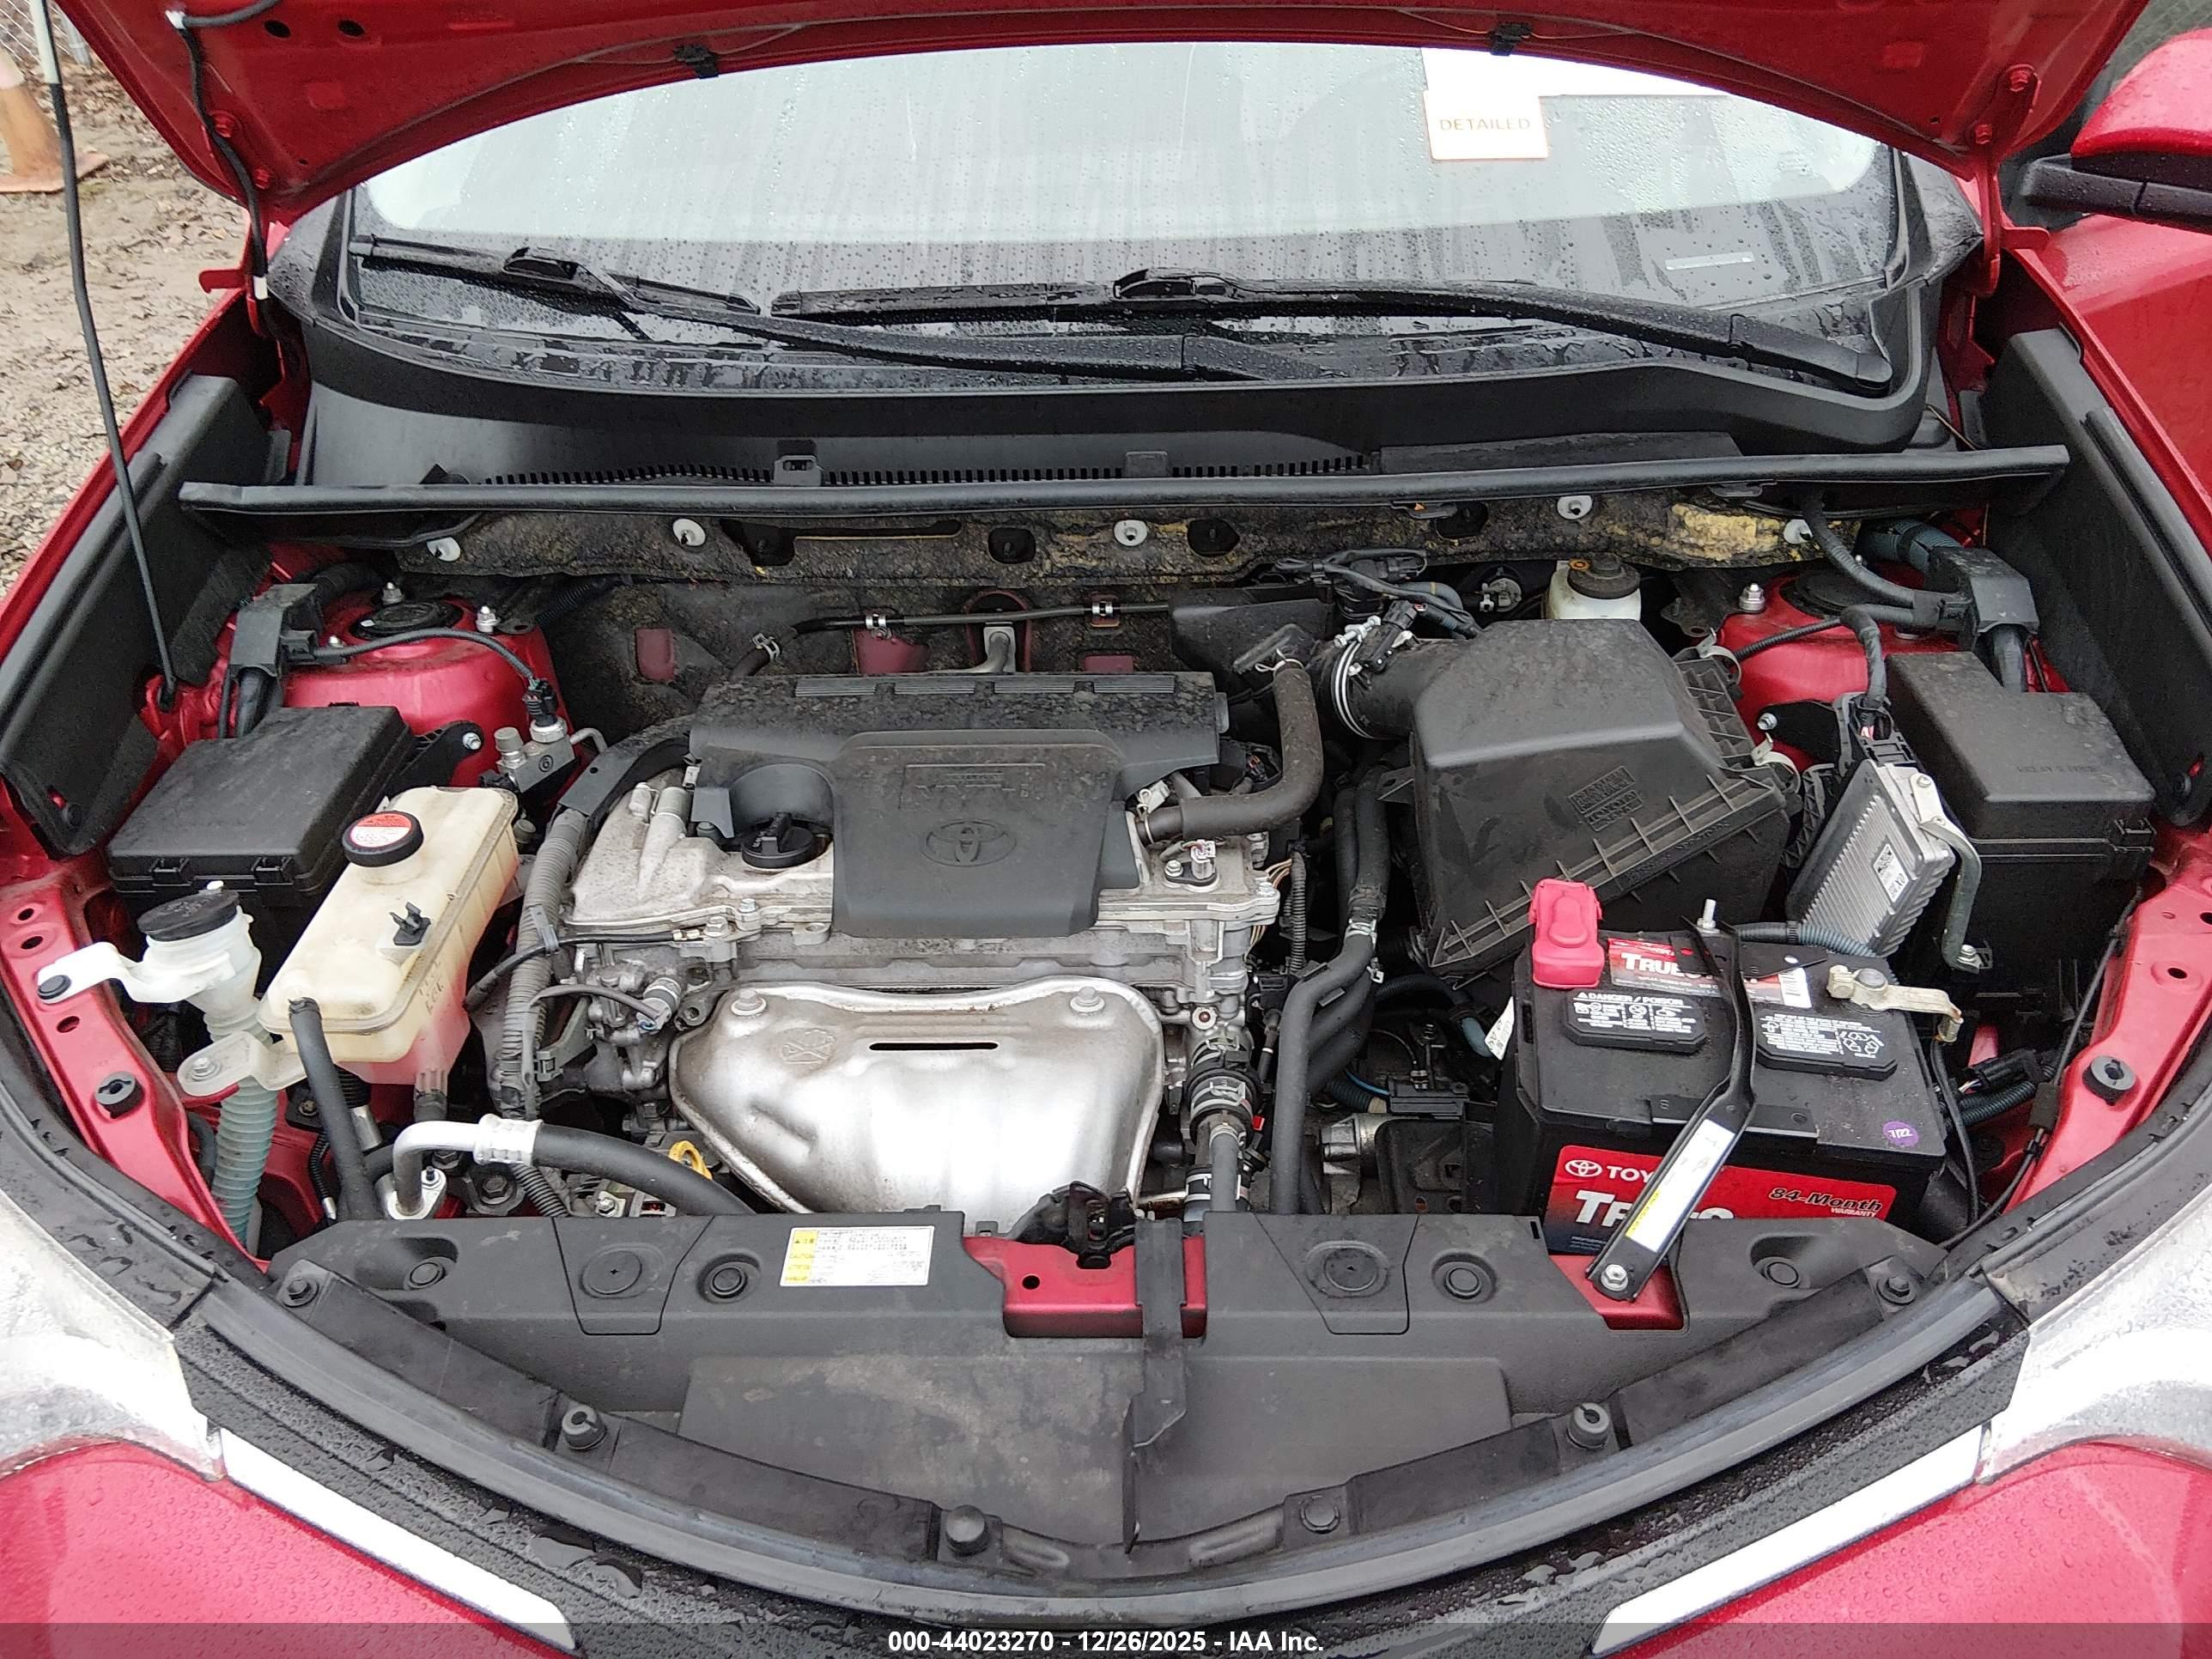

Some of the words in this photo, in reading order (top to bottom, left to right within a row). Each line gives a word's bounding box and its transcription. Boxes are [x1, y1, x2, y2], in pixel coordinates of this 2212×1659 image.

[1439, 118, 1531, 131] DETAILED
[1589, 992, 1632, 1003] DANGER
[1606, 1165, 1656, 1183] TOY
[1769, 1187, 1883, 1212] 84-Month
[1830, 1206, 1878, 1218] WARRANTY
